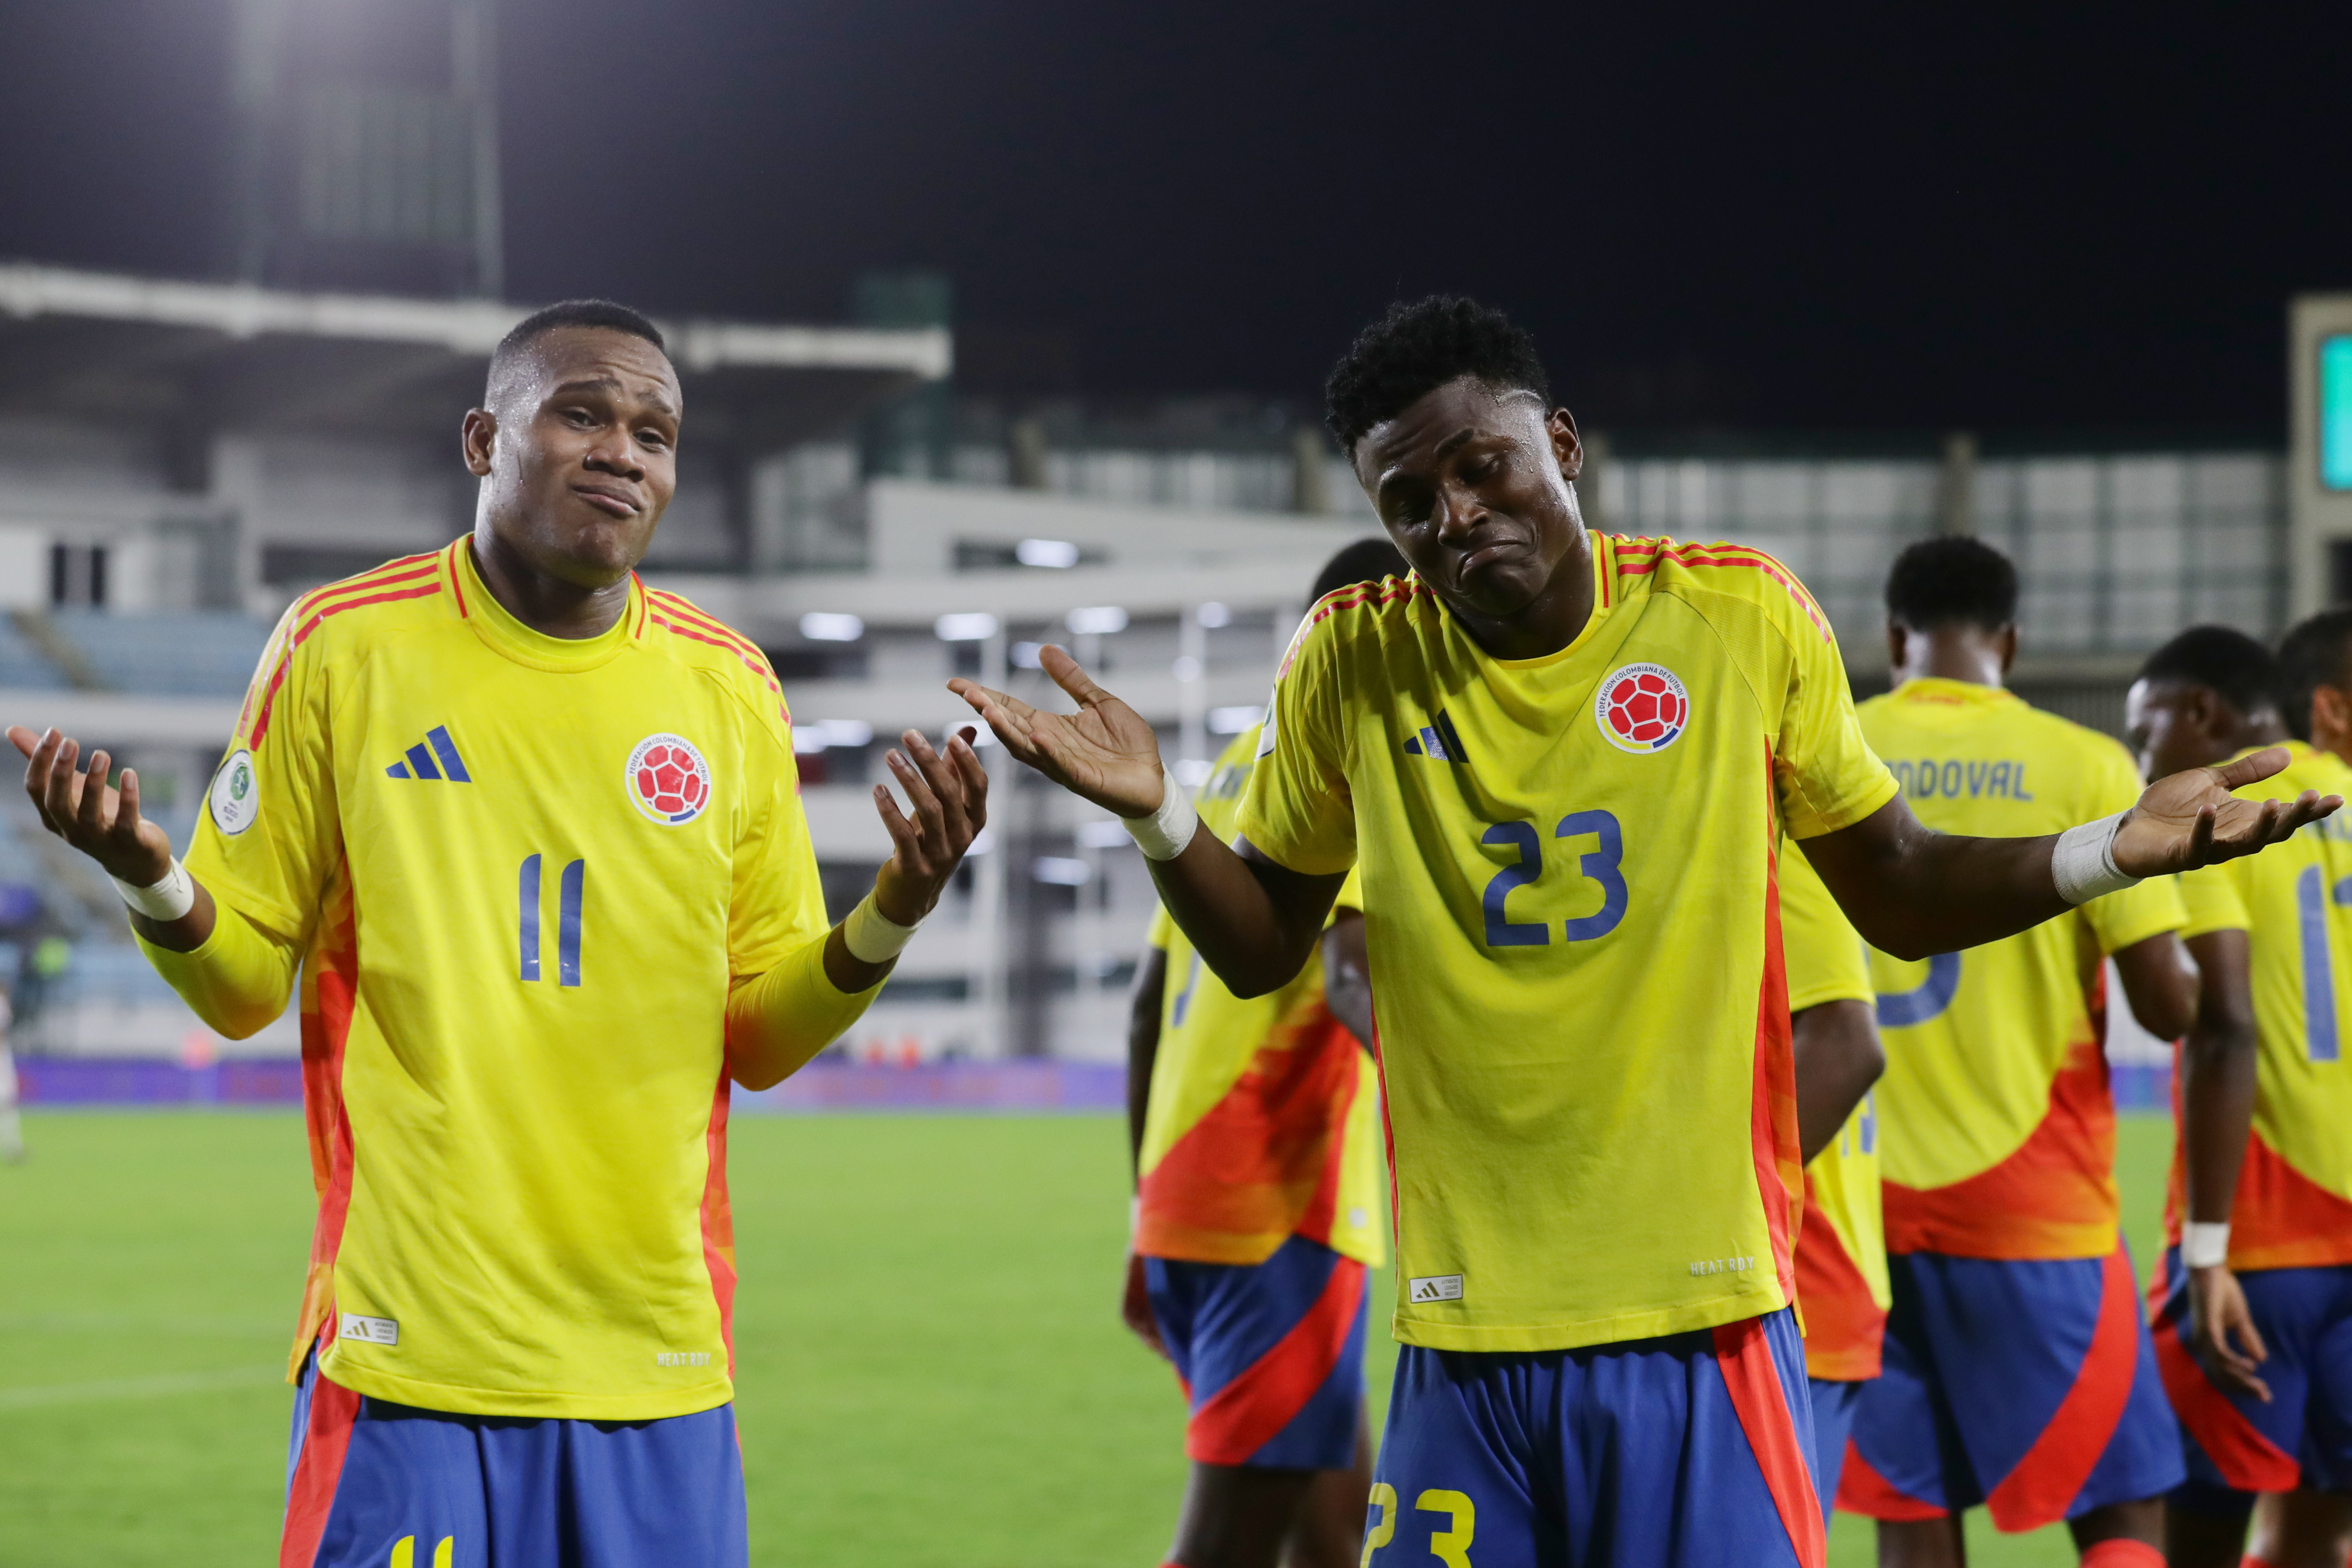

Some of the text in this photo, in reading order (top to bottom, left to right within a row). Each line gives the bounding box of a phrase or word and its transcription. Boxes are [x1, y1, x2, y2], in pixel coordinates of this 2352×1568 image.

[1615, 666, 1657, 680] COLOMBIANA
[1659, 669, 1667, 677] DE
[652, 737, 690, 752] COLOMBIANA
[690, 750, 698, 758] DE
[1884, 760, 2034, 801] NDOVAL
[519, 853, 584, 987] 11
[1482, 809, 1628, 946] 23
[2297, 865, 2352, 1062] 1
